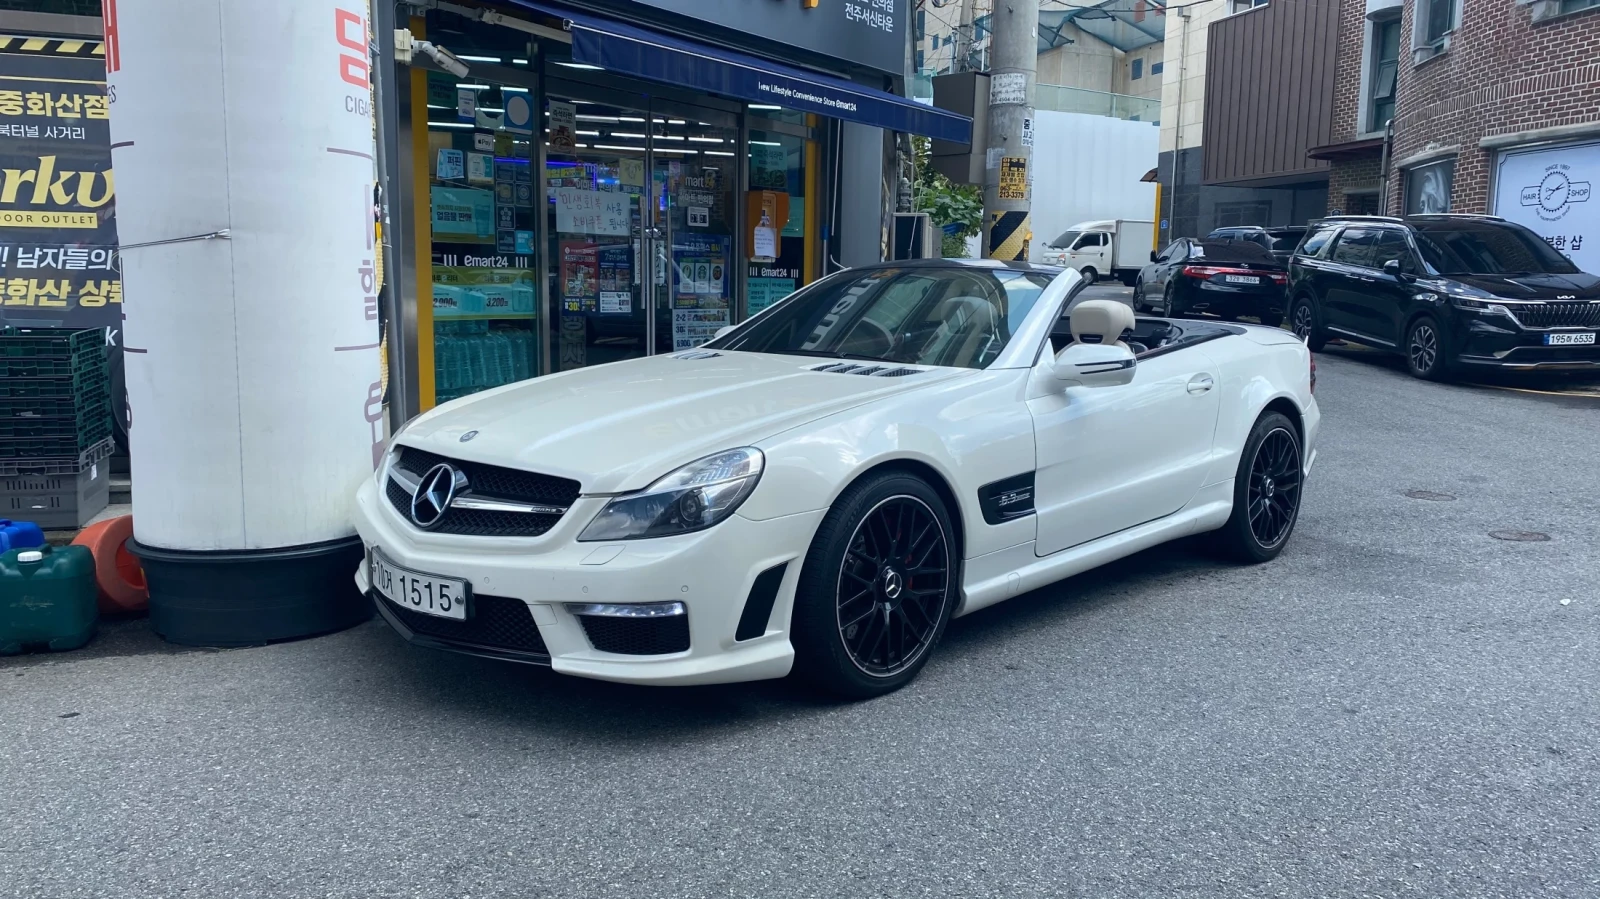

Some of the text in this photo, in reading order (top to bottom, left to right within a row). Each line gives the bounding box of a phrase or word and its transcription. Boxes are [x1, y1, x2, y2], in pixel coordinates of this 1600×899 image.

[845, 2, 894, 33] 전주서신타운
[770, 84, 792, 97] Lifestyle
[792, 89, 823, 104] Convenience
[823, 96, 836, 107] Store
[345, 95, 371, 118] CIGA
[44, 125, 86, 140] 사거리
[1571, 188, 1589, 197] SHOP
[606, 202, 623, 216] 사용
[0, 213, 94, 224] OOR OUTLET
[1570, 234, 1583, 251] 샵
[16, 246, 113, 270] 남자들의
[464, 255, 508, 268] emart24
[761, 267, 788, 277] emart24
[0, 277, 72, 306] 화산
[1573, 334, 1594, 343] 6535
[399, 575, 452, 612] 1515
